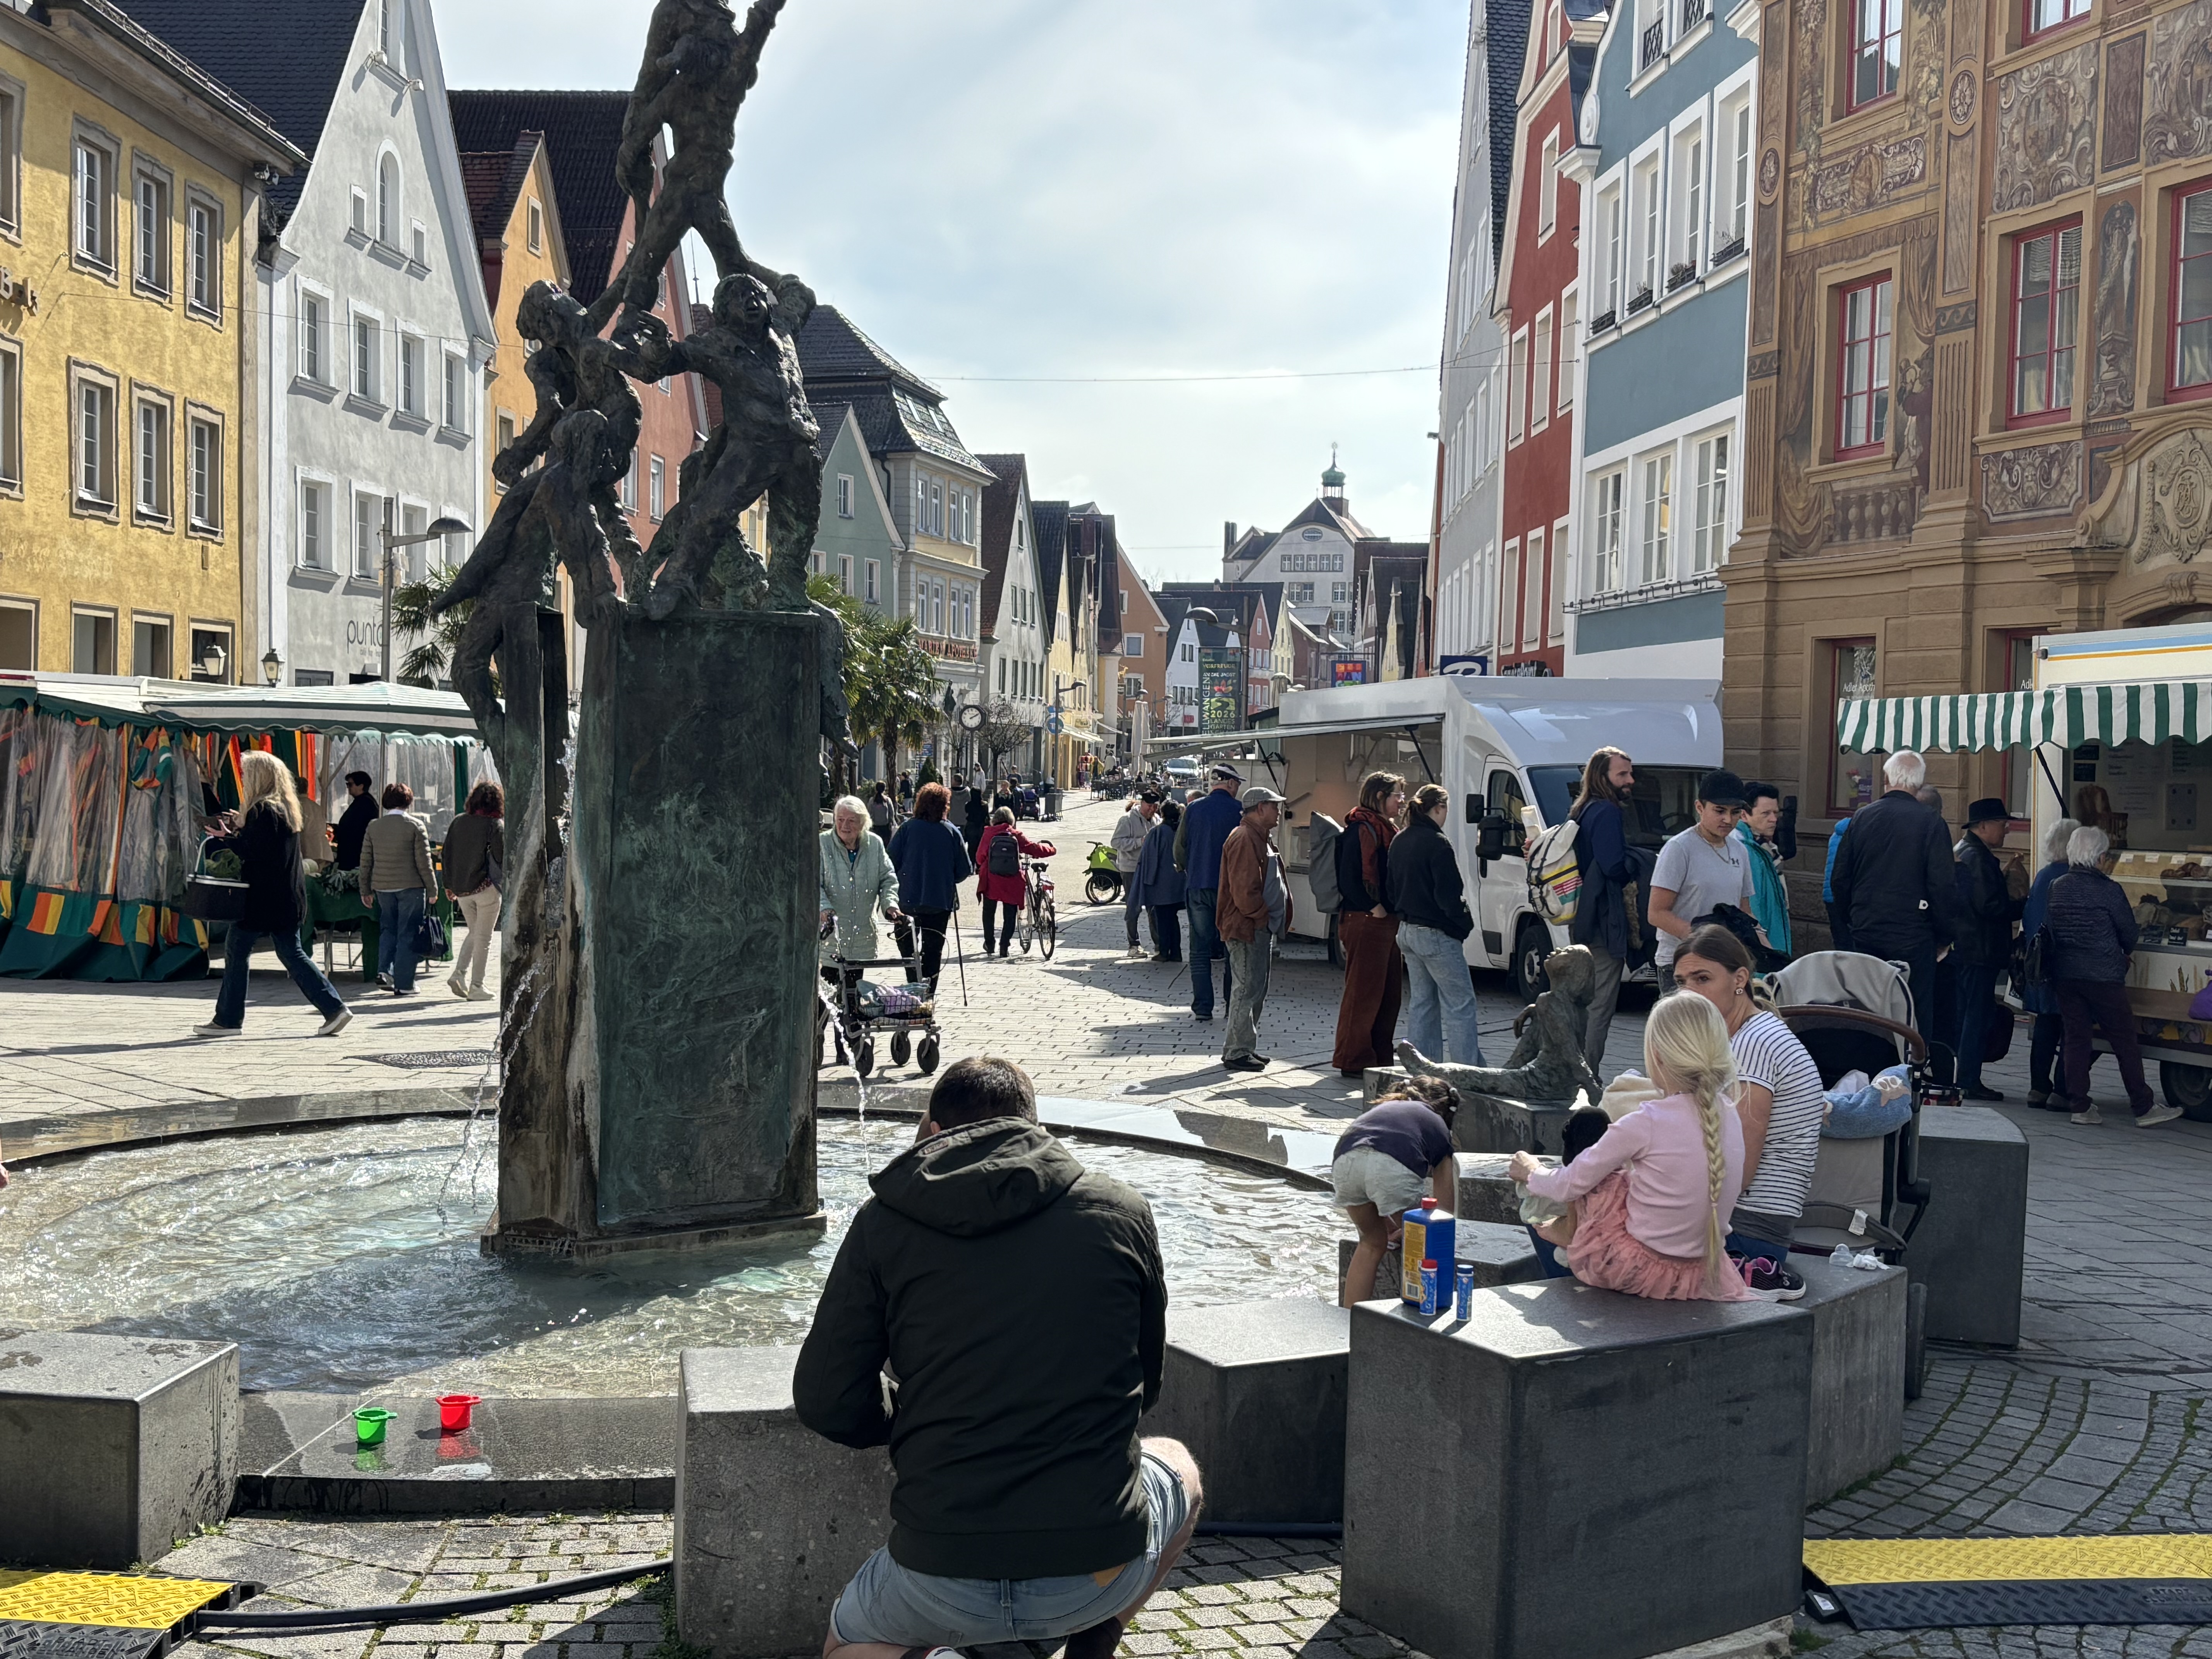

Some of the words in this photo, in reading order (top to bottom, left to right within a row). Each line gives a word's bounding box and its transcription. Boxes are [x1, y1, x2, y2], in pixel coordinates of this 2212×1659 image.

[1843, 682, 1857, 692] Adler
[2020, 678, 2032, 689] Adl
[1202, 677, 1210, 735] ELLWANGEN
